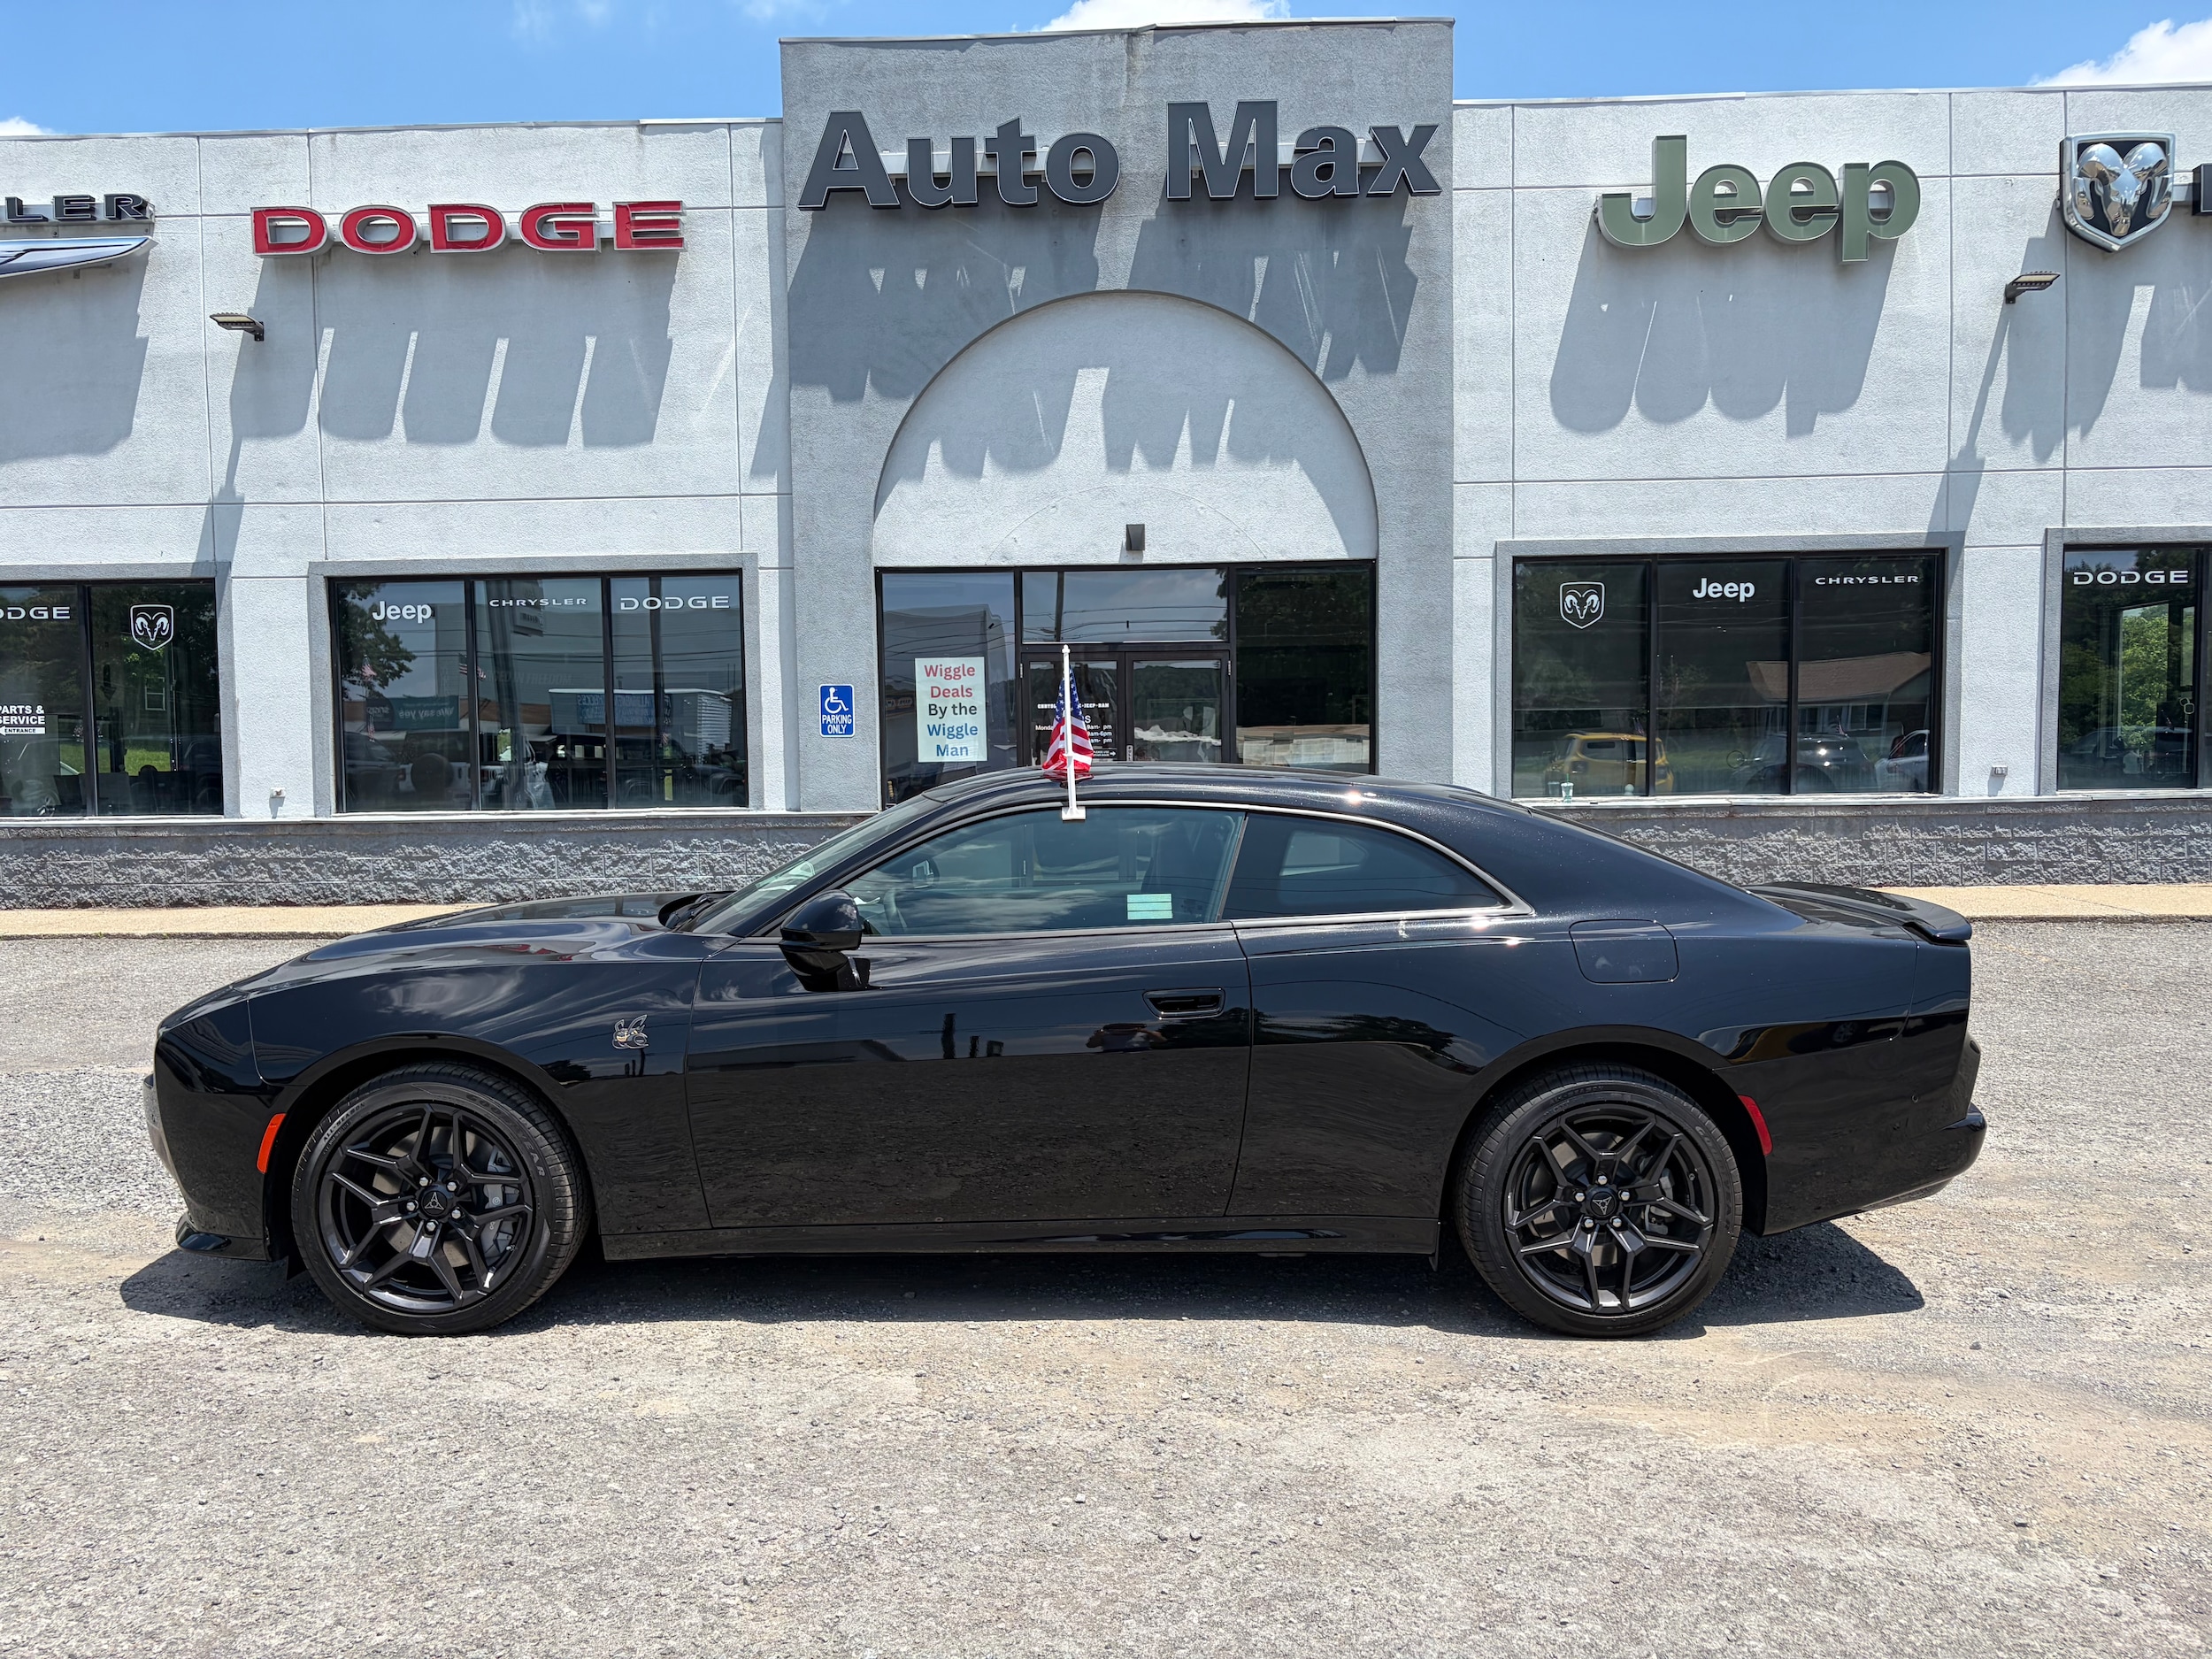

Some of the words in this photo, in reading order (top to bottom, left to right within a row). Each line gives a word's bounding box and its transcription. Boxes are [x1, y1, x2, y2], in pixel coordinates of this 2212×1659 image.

[796, 109, 1120, 211] Auto
[1165, 99, 1442, 201] Max
[1598, 134, 1921, 265] Jeep
[250, 201, 687, 255] DODGE
[1815, 575, 1919, 585] CHRYSLER
[2073, 570, 2189, 586] DODGE
[1693, 578, 1755, 603] Jeep
[488, 598, 588, 607] CHRYSLER
[620, 595, 730, 611] DODGE
[372, 601, 432, 624] Jeep
[924, 664, 976, 680] Wiggle
[931, 685, 973, 699] Deals
[0, 705, 33, 714] ARTS
[35, 705, 45, 714] &
[928, 703, 948, 719] By
[951, 703, 978, 716] the
[822, 714, 852, 725] PARKING
[827, 724, 847, 734] ONLY
[926, 723, 979, 740] Wiggle
[936, 744, 969, 757] Man
